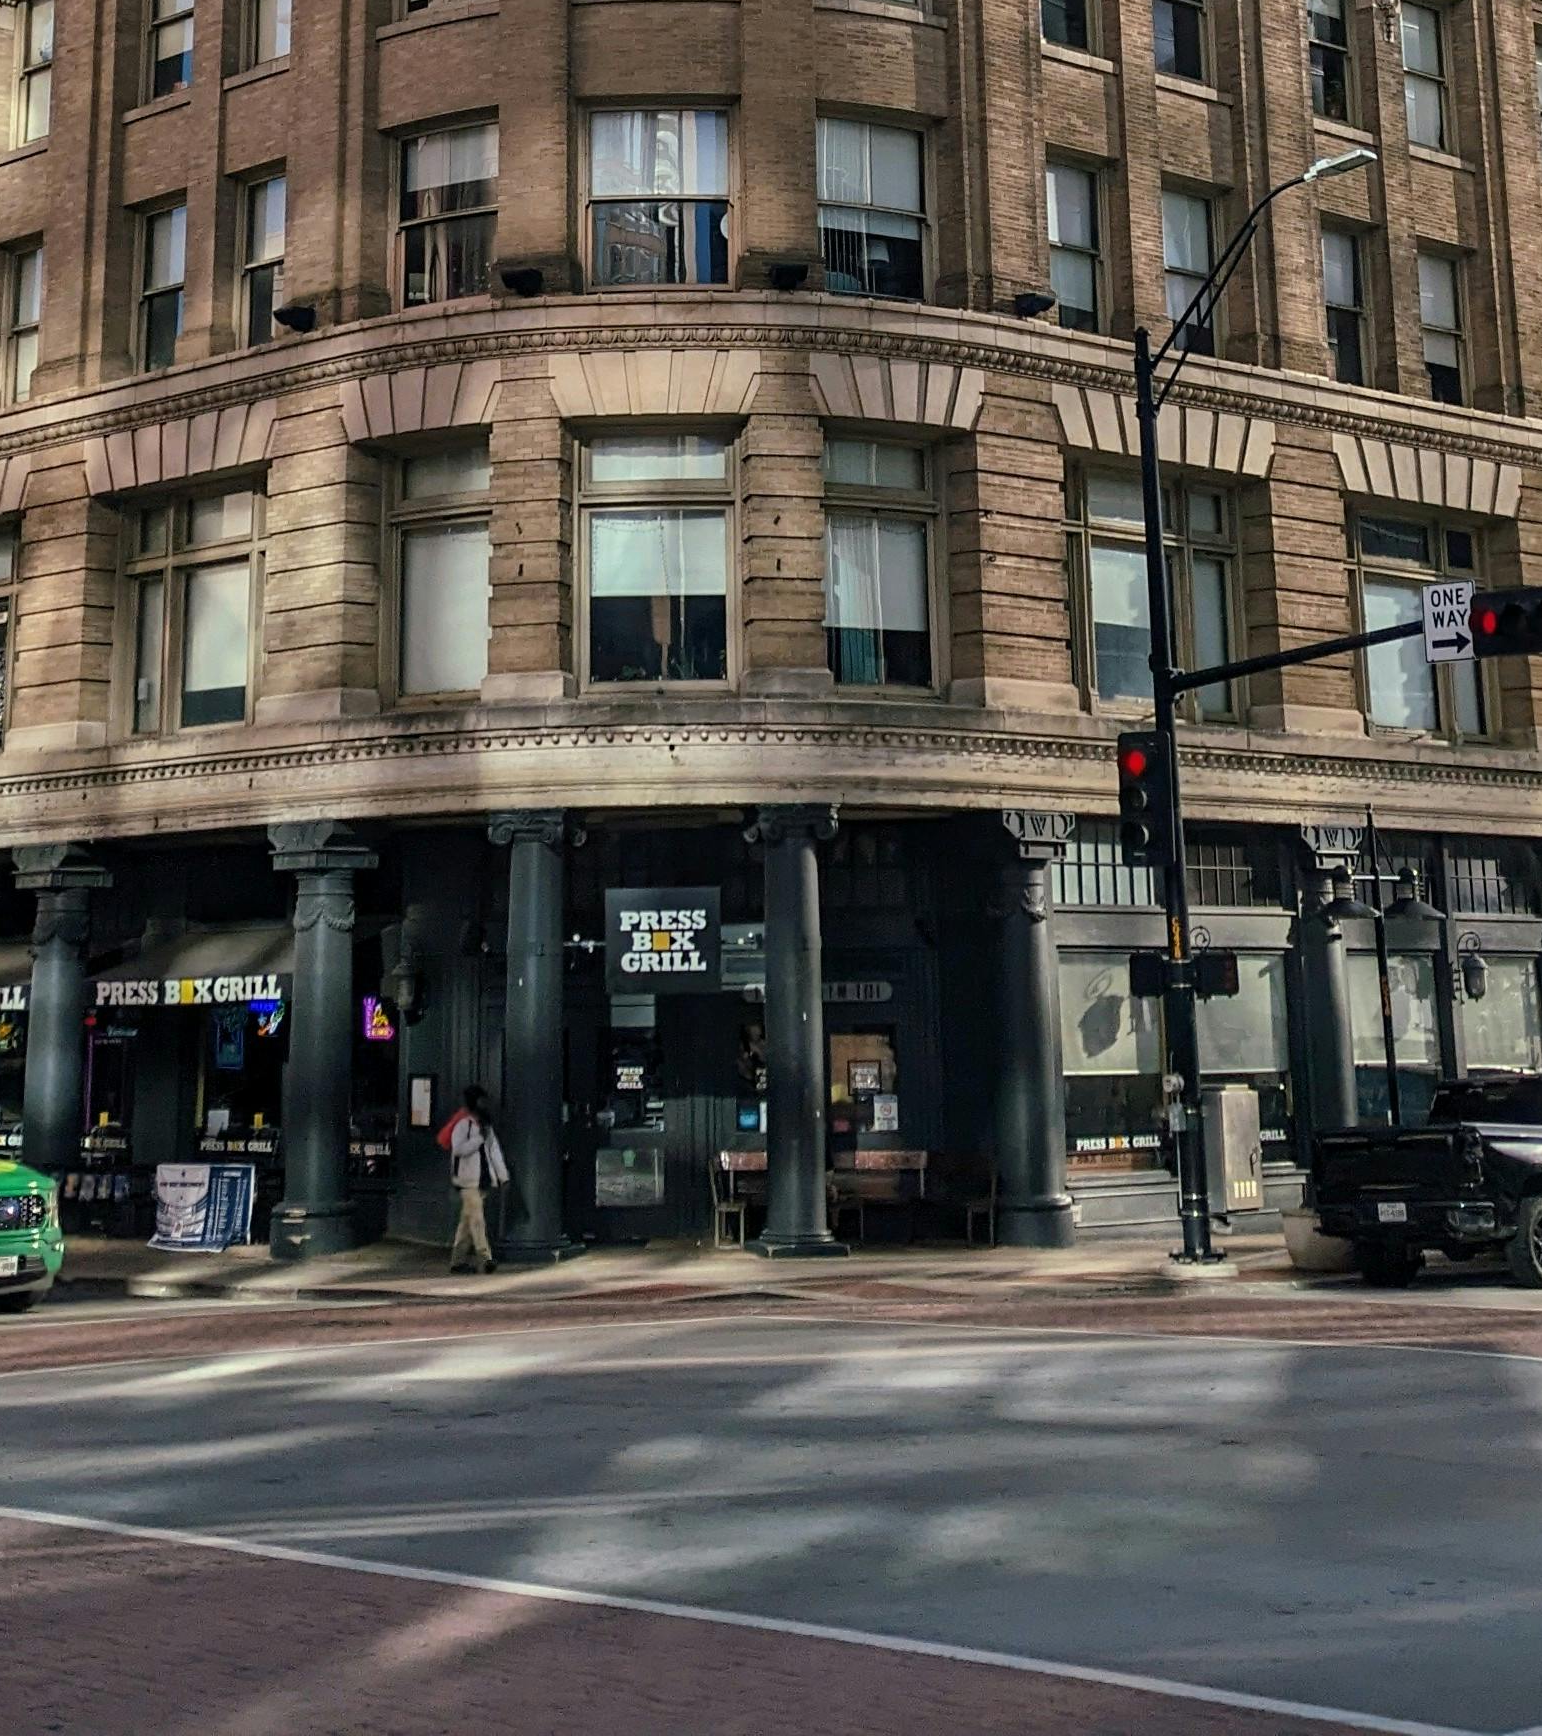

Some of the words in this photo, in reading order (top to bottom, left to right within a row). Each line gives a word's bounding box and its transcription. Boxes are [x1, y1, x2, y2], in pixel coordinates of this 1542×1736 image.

[1431, 588, 1465, 607] ONE
[1432, 608, 1468, 629] WAY
[620, 909, 707, 932] PRESS
[621, 951, 707, 972] GRILL
[95, 980, 159, 1006] PRESS
[213, 974, 281, 1002] GRILL
[1076, 1137, 1106, 1151] PRESS
[1132, 1135, 1161, 1148] GRILL
[1260, 1129, 1287, 1141] GRILL
[200, 1140, 225, 1151] PRESS
[247, 1140, 273, 1152] GRILL
